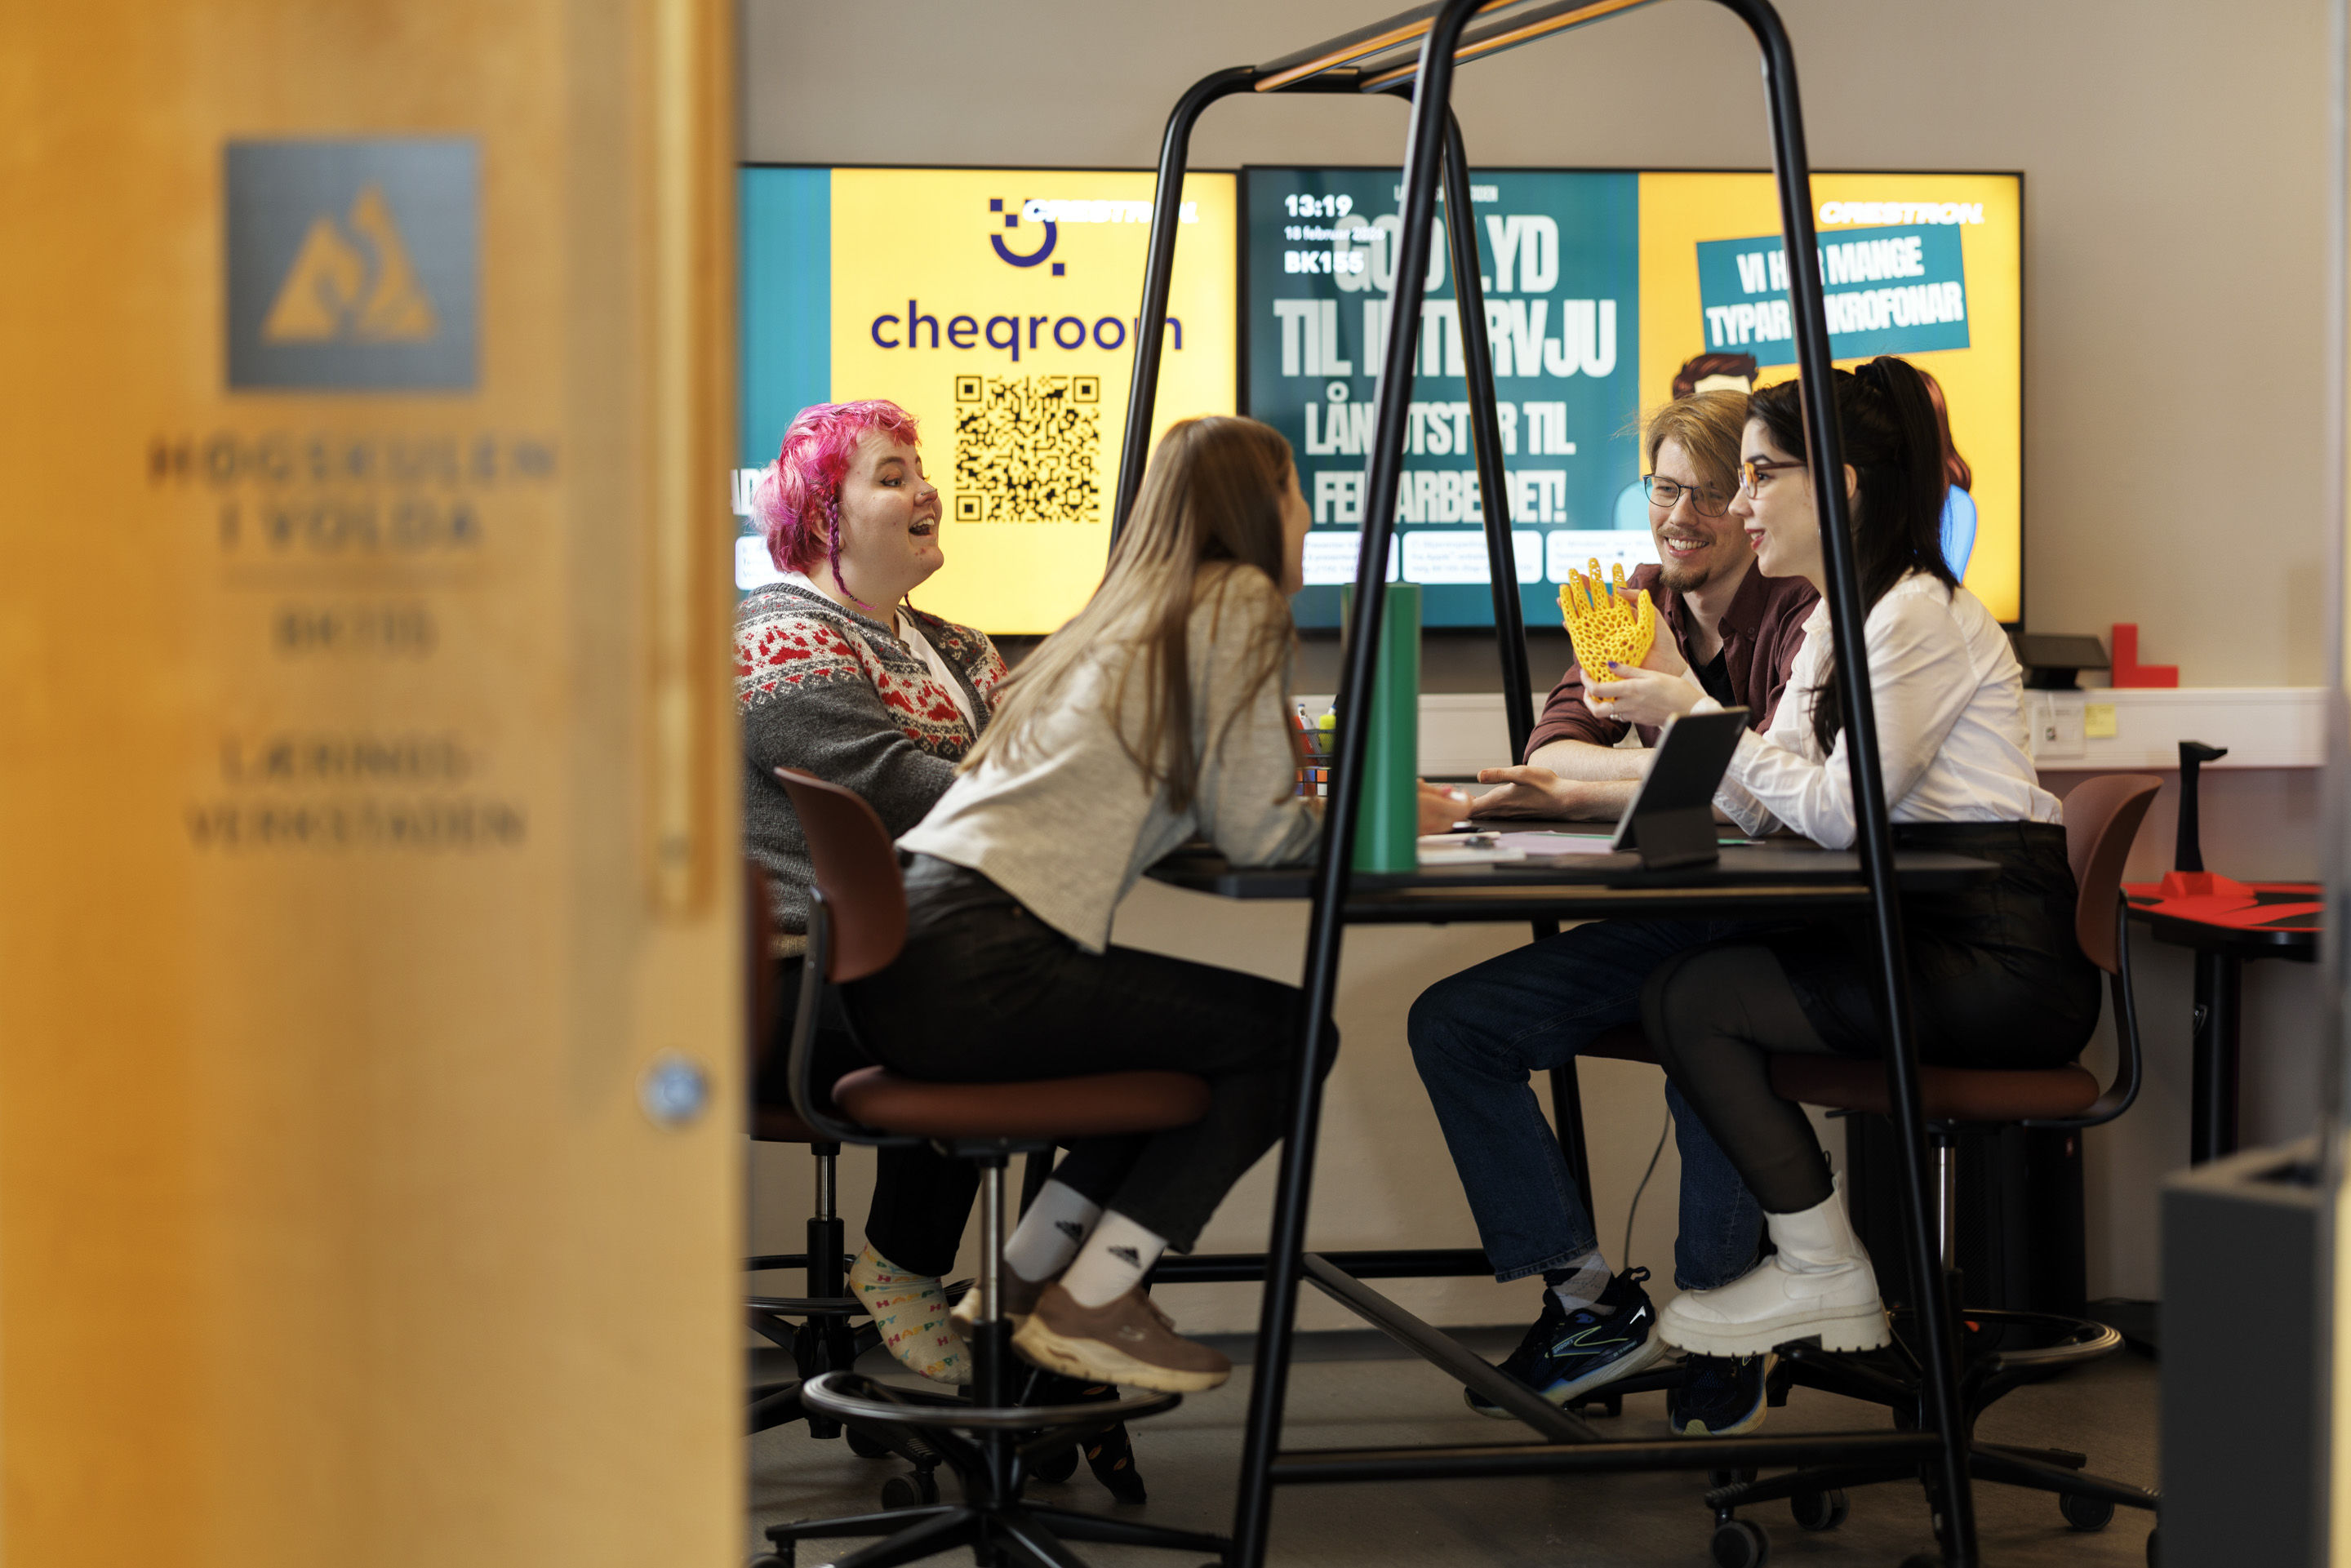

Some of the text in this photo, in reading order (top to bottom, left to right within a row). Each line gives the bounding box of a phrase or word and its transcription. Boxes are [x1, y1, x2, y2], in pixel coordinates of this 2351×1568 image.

[1285, 193, 1353, 217] 13:19
[1284, 251, 1365, 274] BK155
[1736, 251, 1767, 294] VI
[1825, 235, 1925, 285] MANGE
[1273, 299, 1353, 377] TIL
[1705, 299, 1793, 347] TYPAR
[1304, 381, 1375, 455] LÅN
[1522, 401, 1577, 455] TIL
[888, 1318, 945, 1347] HAPPY
